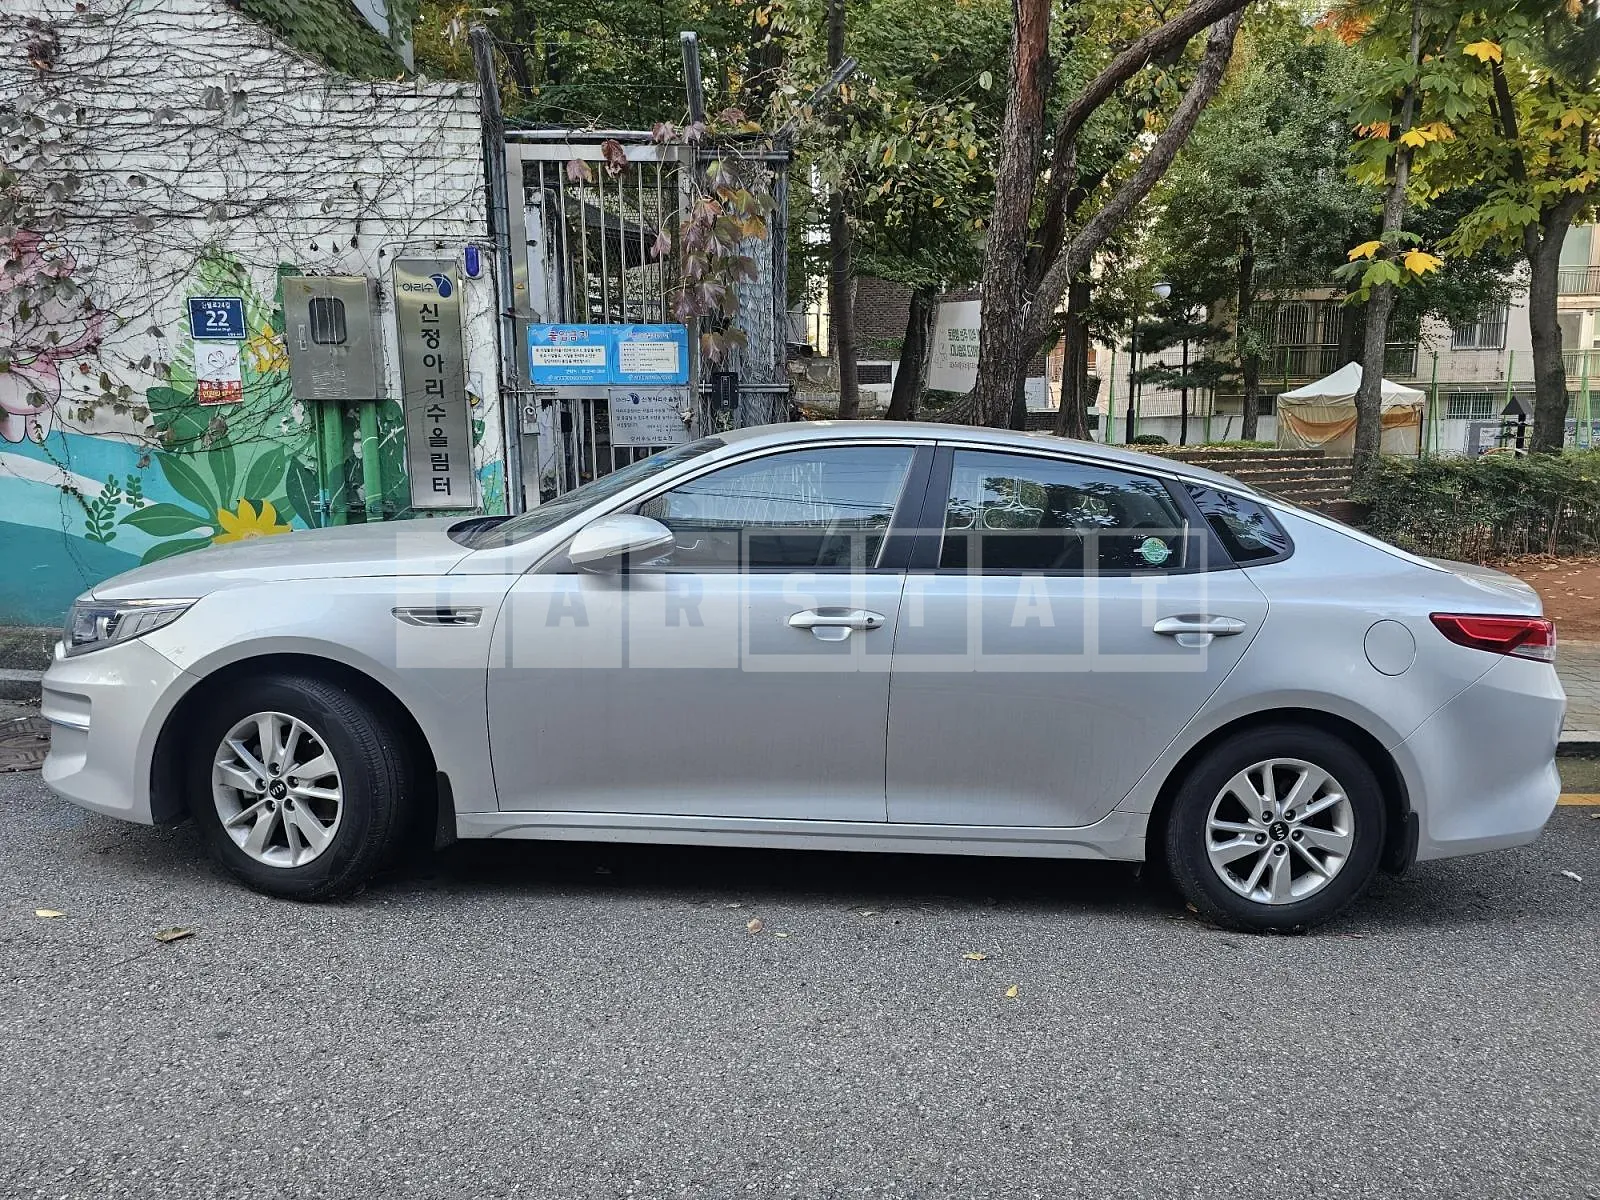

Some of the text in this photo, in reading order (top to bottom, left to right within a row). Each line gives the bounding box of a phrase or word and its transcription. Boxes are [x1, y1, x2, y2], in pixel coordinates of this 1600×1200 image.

[402, 283, 433, 292] 아리수
[206, 310, 229, 326] 22
[548, 329, 589, 341] 출입금지
[420, 304, 451, 496] 신정아리수올림터
